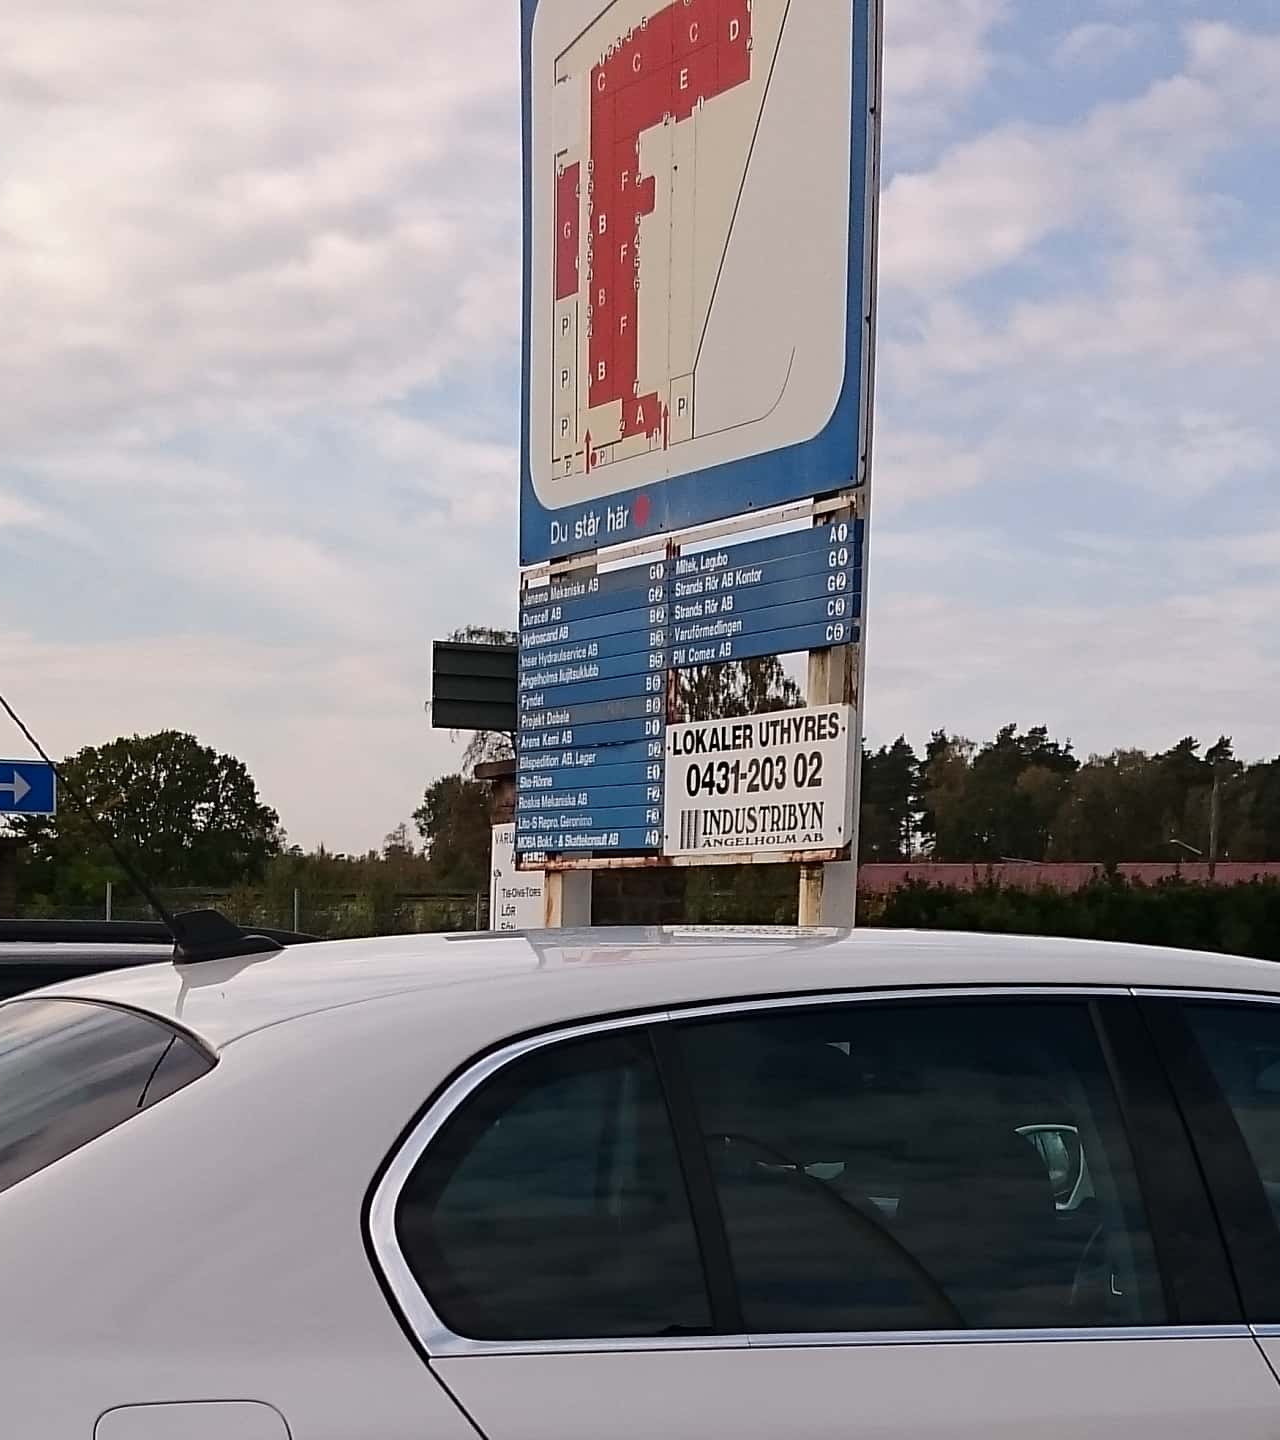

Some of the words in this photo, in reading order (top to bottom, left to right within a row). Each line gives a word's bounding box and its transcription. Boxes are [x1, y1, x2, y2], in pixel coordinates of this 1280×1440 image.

[689, 22, 698, 43] C
[729, 19, 738, 41] D
[632, 54, 641, 72] C
[597, 72, 606, 91] C
[680, 69, 688, 89] E
[621, 170, 629, 191] F
[563, 222, 570, 239] G
[599, 214, 606, 234] B
[620, 244, 628, 264] F
[598, 288, 606, 306] B
[562, 317, 569, 336] P
[620, 315, 627, 336] F
[562, 370, 568, 388] P
[598, 361, 606, 381] B
[636, 405, 644, 424] A
[678, 398, 685, 416] P
[561, 419, 568, 436] P
[551, 521, 568, 544] Du
[575, 511, 600, 539] står
[607, 505, 630, 532] här
[588, 578, 599, 592] AB
[675, 578, 702, 597] Strands
[705, 575, 719, 593] Rör
[721, 573, 733, 587] AB
[736, 568, 762, 585] Kontor
[522, 611, 549, 627] Duracell
[551, 606, 561, 621] AB
[675, 601, 702, 620] Strands
[705, 597, 718, 615] Rör
[721, 596, 733, 611] AB
[559, 626, 569, 639] AB
[675, 619, 743, 641] Varuförmedlingen
[588, 643, 598, 657] AB
[673, 650, 685, 665] PM
[688, 647, 715, 663] Comex
[719, 643, 731, 657] AB
[521, 692, 544, 710] Fyndet
[521, 711, 545, 729] Projekt
[542, 732, 559, 746] Kemi
[562, 730, 572, 744] AB
[673, 724, 753, 756] LOKALER
[759, 712, 839, 748] UTHYRES
[576, 752, 596, 767] Lager
[686, 755, 787, 797] 0431-203
[793, 751, 823, 789] 02
[577, 792, 588, 806] AB
[702, 801, 824, 836] INDUSTRIBYN
[608, 832, 619, 845] AB
[802, 832, 824, 843] AB
